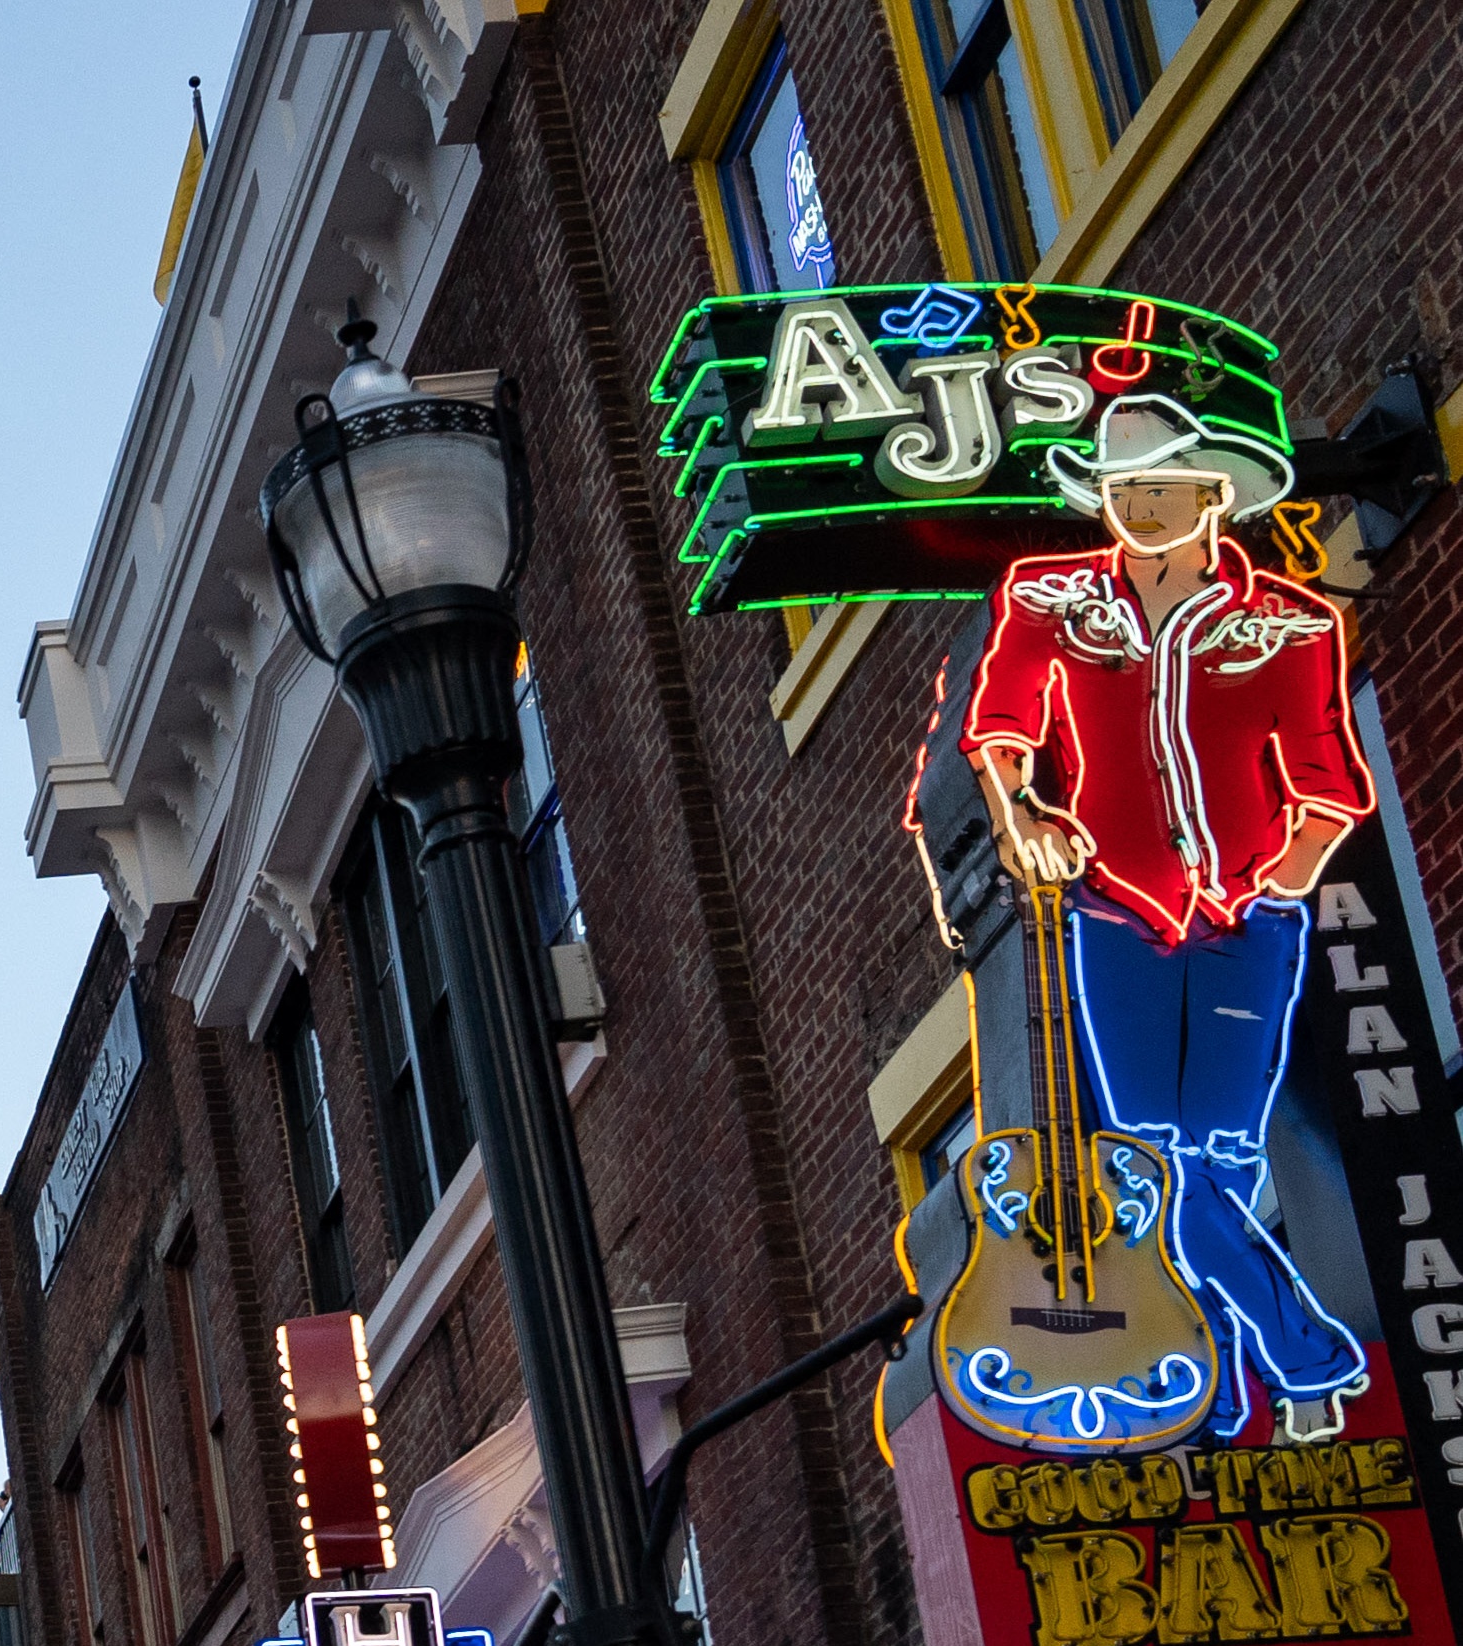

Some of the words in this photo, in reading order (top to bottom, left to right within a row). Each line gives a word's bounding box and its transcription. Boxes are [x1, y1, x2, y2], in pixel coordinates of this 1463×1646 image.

[1317, 883, 1419, 1118] ALAN
[966, 1456, 1186, 1532] GOOD
[1211, 1438, 1417, 1515] TIME
